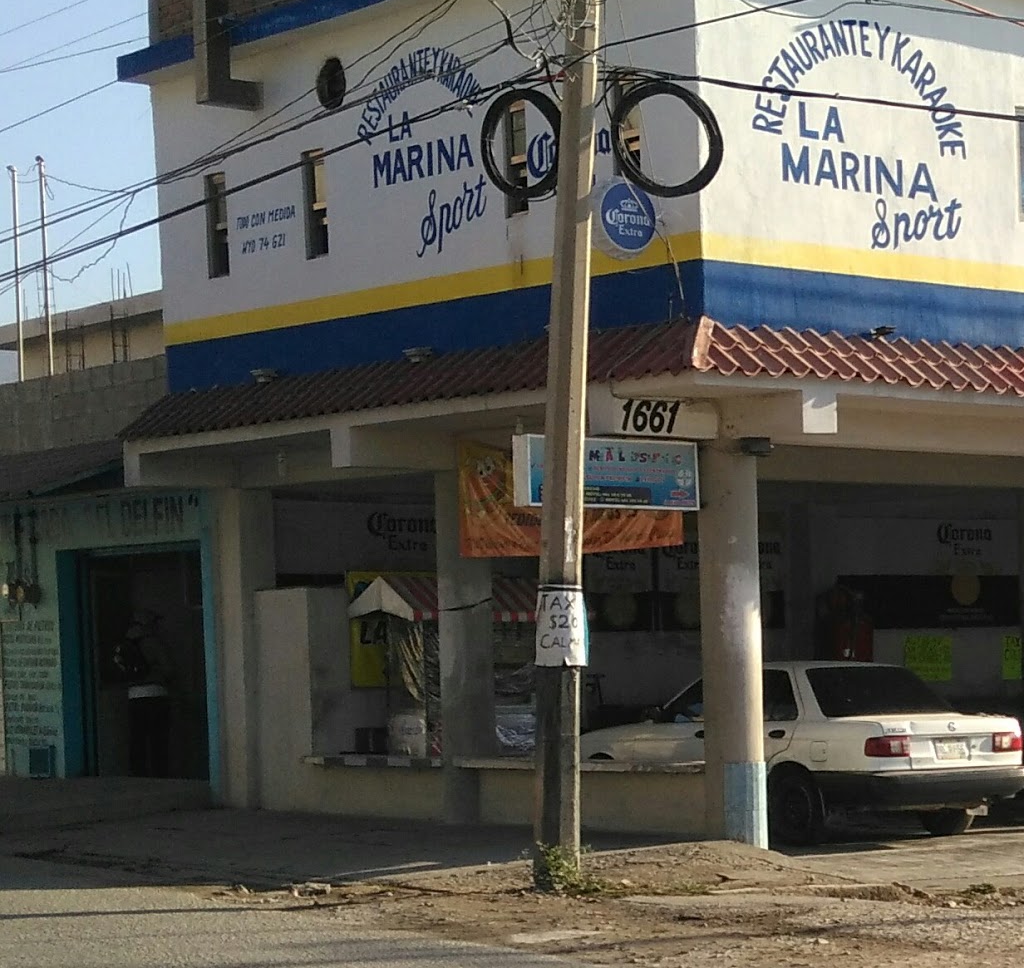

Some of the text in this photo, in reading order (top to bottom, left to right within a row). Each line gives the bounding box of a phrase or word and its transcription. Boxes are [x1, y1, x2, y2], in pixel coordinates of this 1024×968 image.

[388, 111, 412, 142] LA
[798, 100, 845, 143] LA
[373, 134, 474, 189] MARINA
[781, 142, 938, 203] MARINA
[251, 211, 266, 228] CON
[267, 205, 296, 223] MEDIDA
[416, 174, 487, 257] Sport
[605, 208, 650, 228] Corona
[618, 224, 643, 237] Extra
[871, 198, 962, 249] Sport
[622, 398, 681, 434] 1661
[936, 523, 992, 546] Corona
